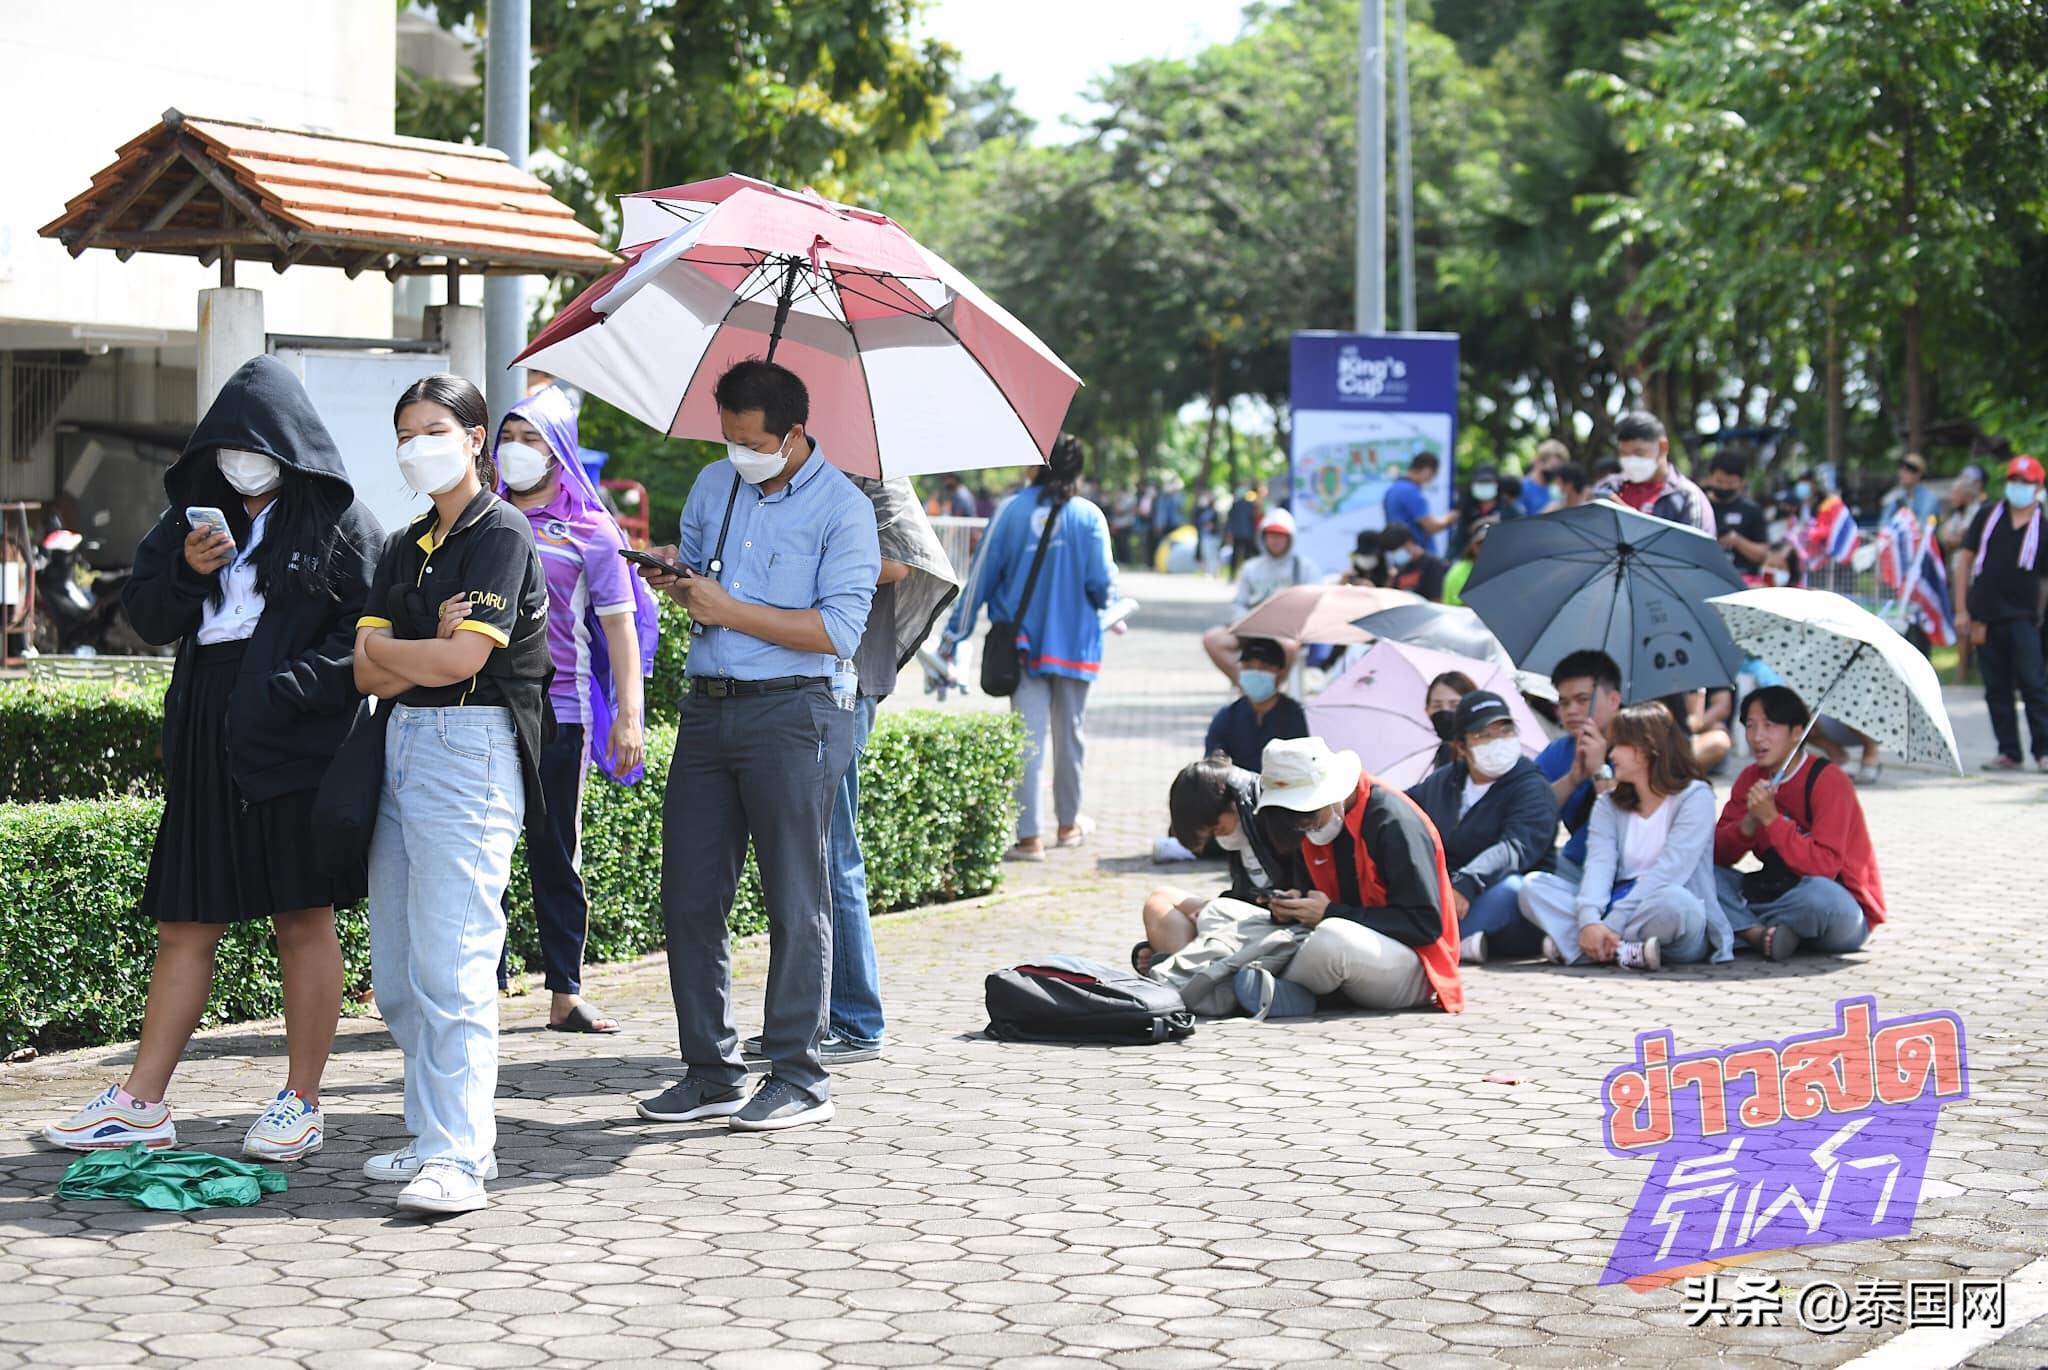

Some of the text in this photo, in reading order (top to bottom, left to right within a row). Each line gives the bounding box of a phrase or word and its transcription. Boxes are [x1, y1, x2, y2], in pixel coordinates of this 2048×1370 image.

[1338, 356, 1406, 380] King's
[1338, 377, 1385, 399] Cup
[469, 591, 508, 611] CMRU
